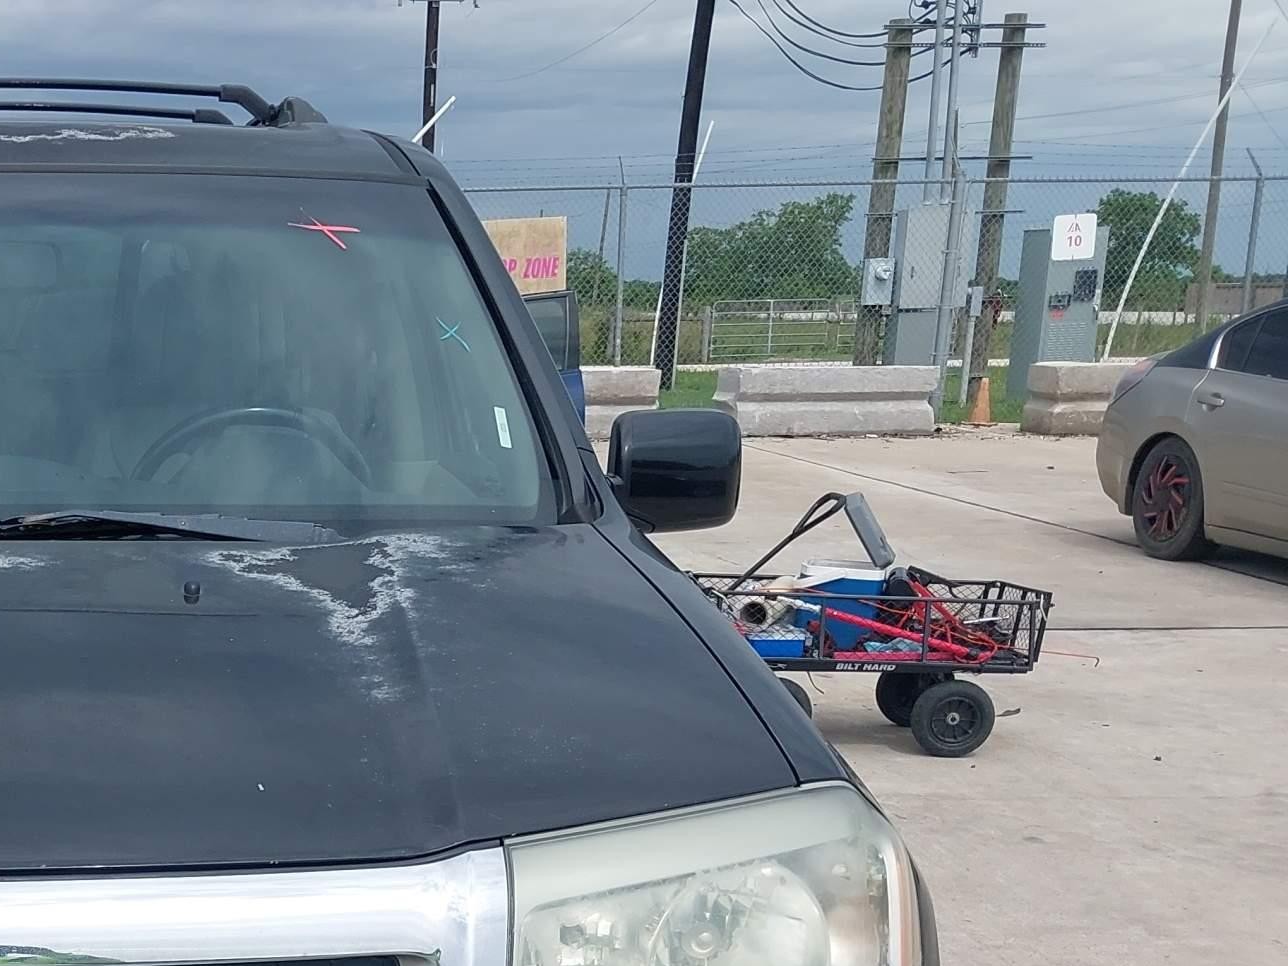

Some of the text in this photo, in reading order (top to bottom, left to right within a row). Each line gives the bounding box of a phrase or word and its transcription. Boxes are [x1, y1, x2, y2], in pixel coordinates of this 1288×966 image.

[1066, 235, 1082, 247] 10
[523, 256, 560, 279] ZONE
[835, 663, 896, 671] BILT HARD
